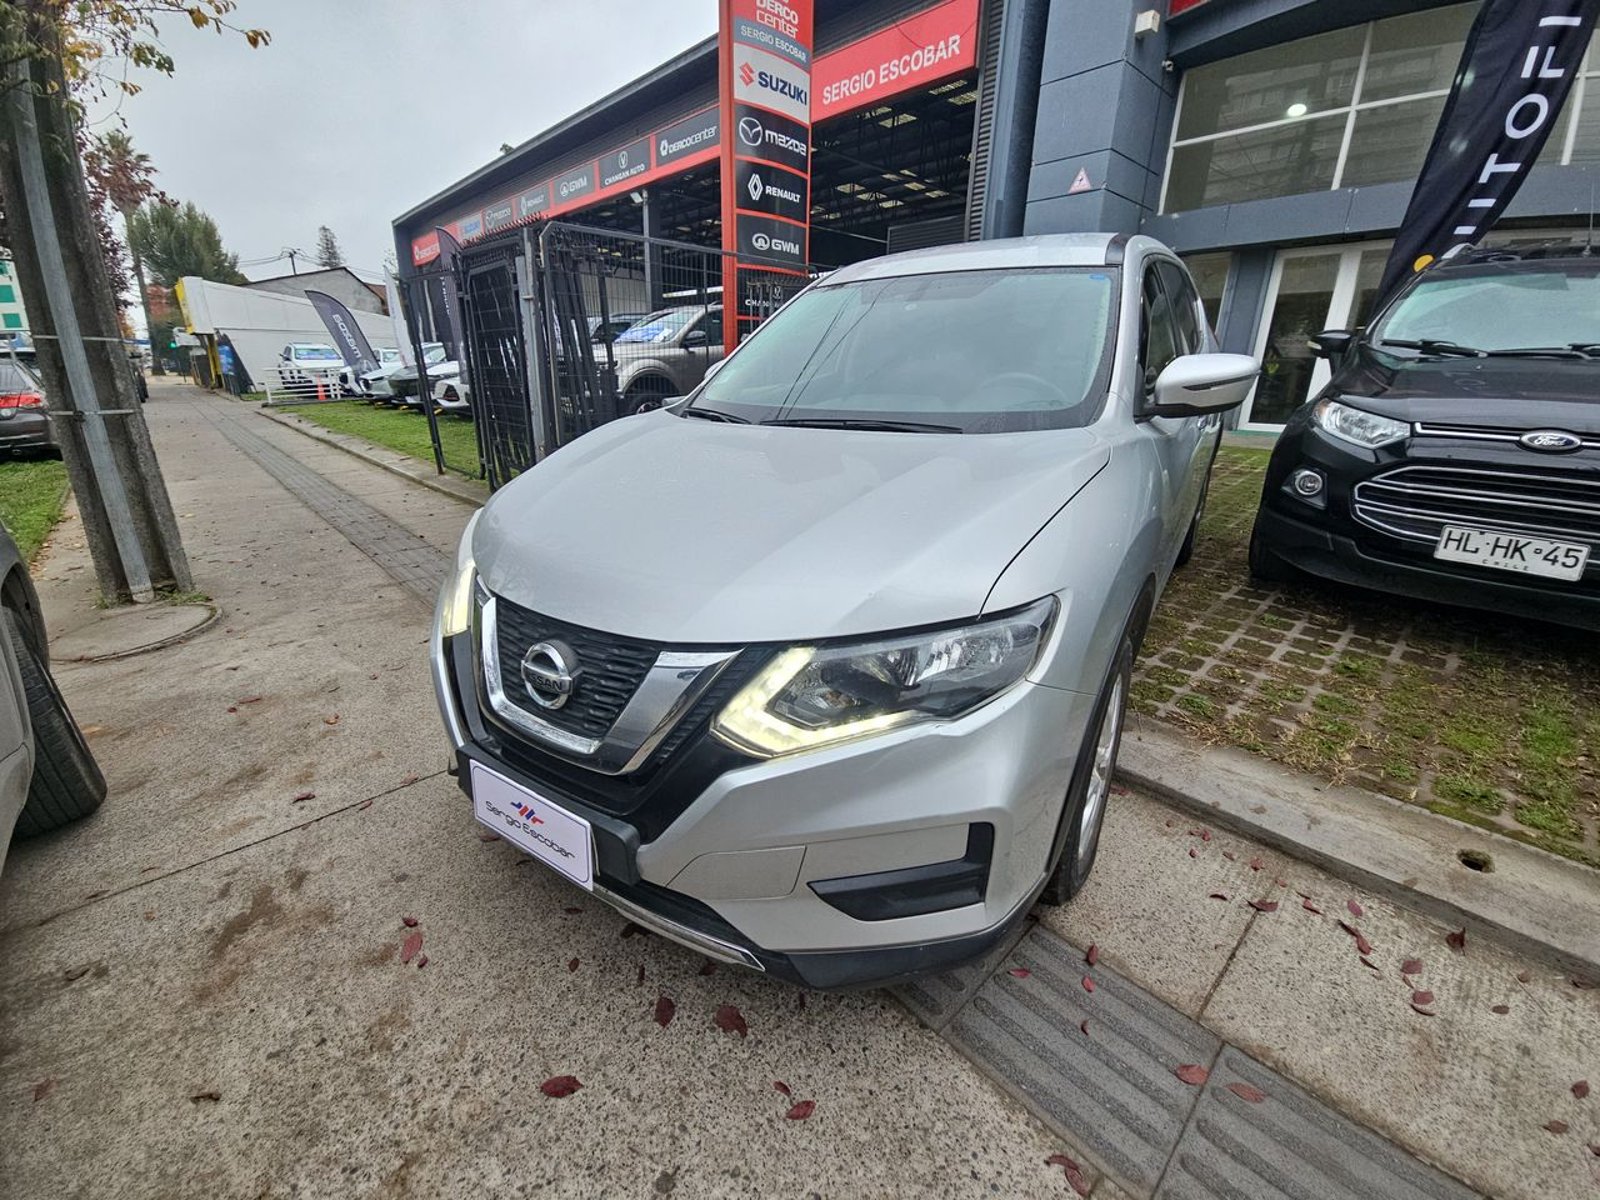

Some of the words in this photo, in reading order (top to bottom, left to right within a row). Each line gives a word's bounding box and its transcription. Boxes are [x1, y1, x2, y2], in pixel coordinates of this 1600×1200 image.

[756, 0, 799, 25] DERCO
[756, 10, 799, 39] center
[740, 25, 774, 45] SERGIO
[775, 38, 807, 63] ESCOBAR
[822, 69, 876, 105] SERGIO
[879, 34, 961, 84] ESCOBAR
[758, 71, 807, 106] SUZUKI
[569, 176, 589, 192] GWM
[604, 171, 630, 186] CHANGAN
[629, 163, 646, 176] AUTO
[765, 185, 801, 203] RENAULT
[771, 238, 800, 255] GWM
[1534, 435, 1568, 446] Ford
[522, 823, 576, 859] Escobar
